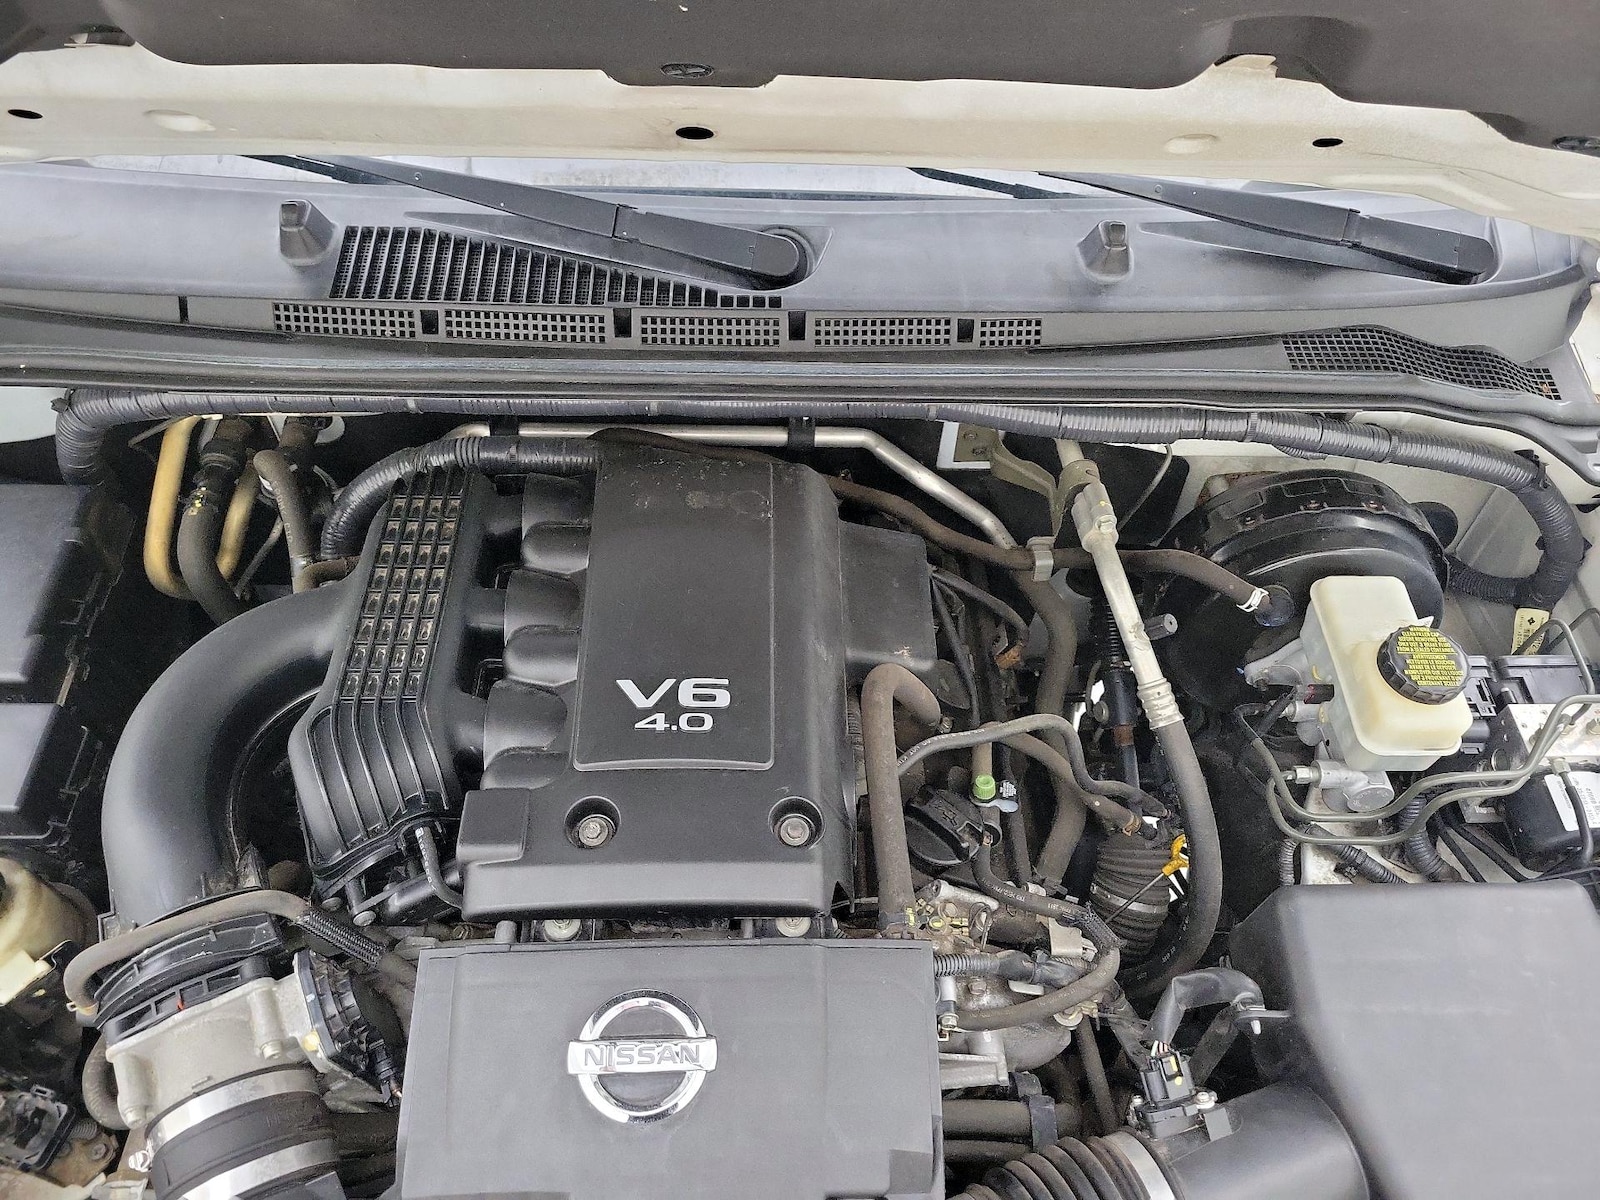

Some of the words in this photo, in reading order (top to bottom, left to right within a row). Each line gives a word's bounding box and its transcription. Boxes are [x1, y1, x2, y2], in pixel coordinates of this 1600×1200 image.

[616, 678, 731, 709] V6
[634, 712, 714, 733] 4.0
[584, 1044, 701, 1066] NISSAN
